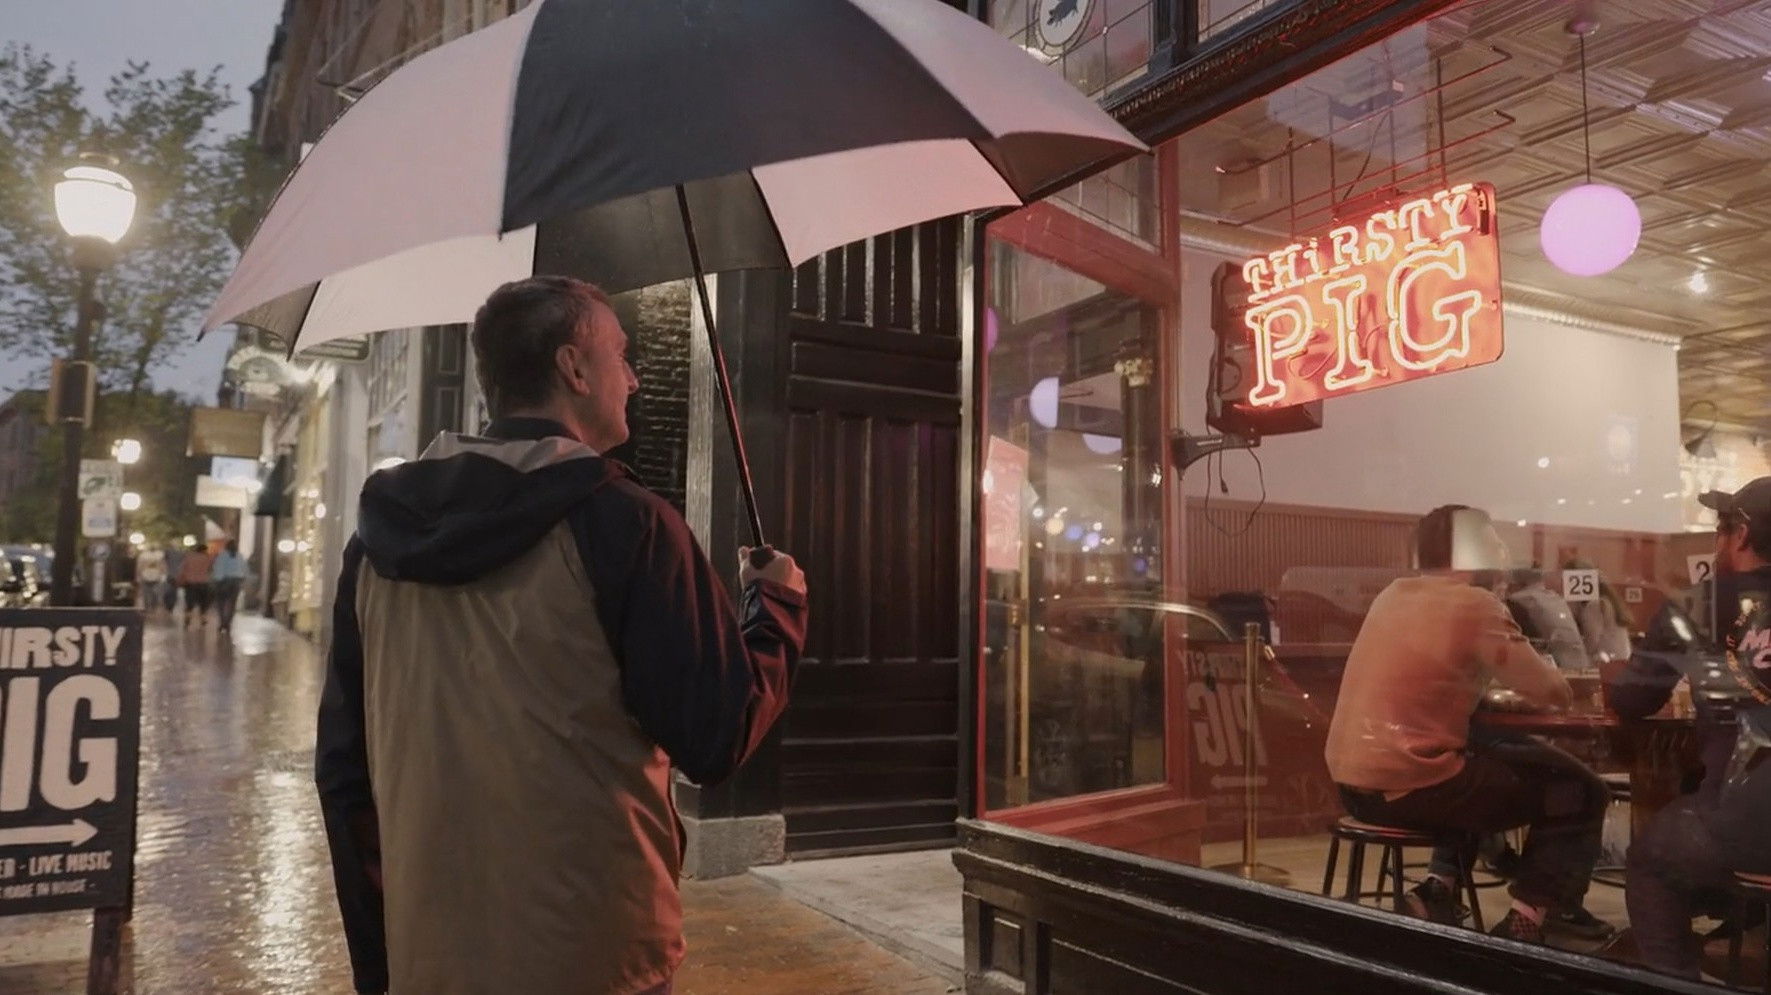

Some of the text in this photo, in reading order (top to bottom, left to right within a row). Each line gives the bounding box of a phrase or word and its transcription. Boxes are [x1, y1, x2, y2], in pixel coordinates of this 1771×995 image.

[1245, 239, 1482, 406] PIG
[1568, 574, 1594, 596] 25
[0, 625, 127, 669] IRSTY
[0, 673, 120, 811] IG
[28, 854, 64, 876] LIVE
[66, 850, 113, 873] MUSIC
